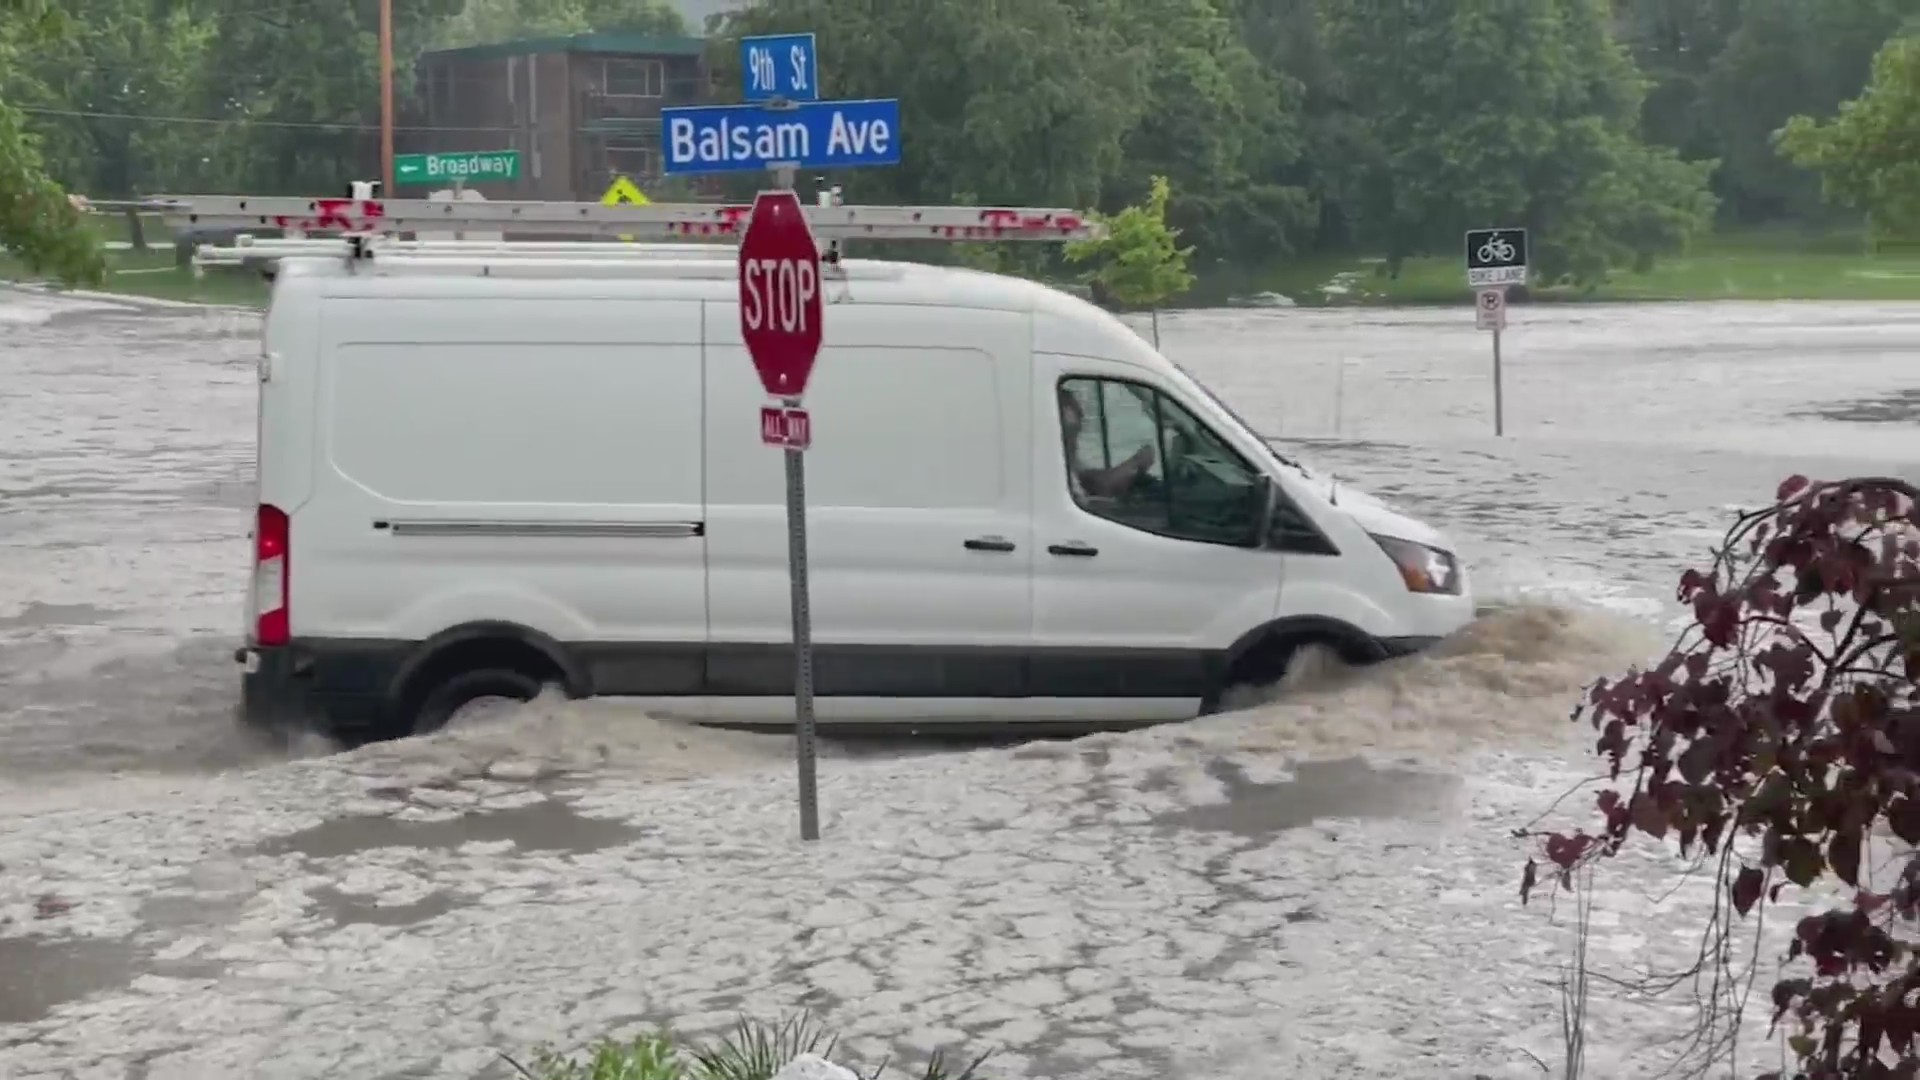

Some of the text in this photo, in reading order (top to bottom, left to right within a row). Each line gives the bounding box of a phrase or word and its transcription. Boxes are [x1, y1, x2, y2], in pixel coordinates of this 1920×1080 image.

[750, 45, 808, 91] 9th St
[671, 111, 890, 163] Balsam Ave
[427, 155, 514, 177] Broadway
[1470, 267, 1524, 283] BIKE LANE
[745, 257, 815, 332] STOP
[765, 413, 783, 438] ALL
